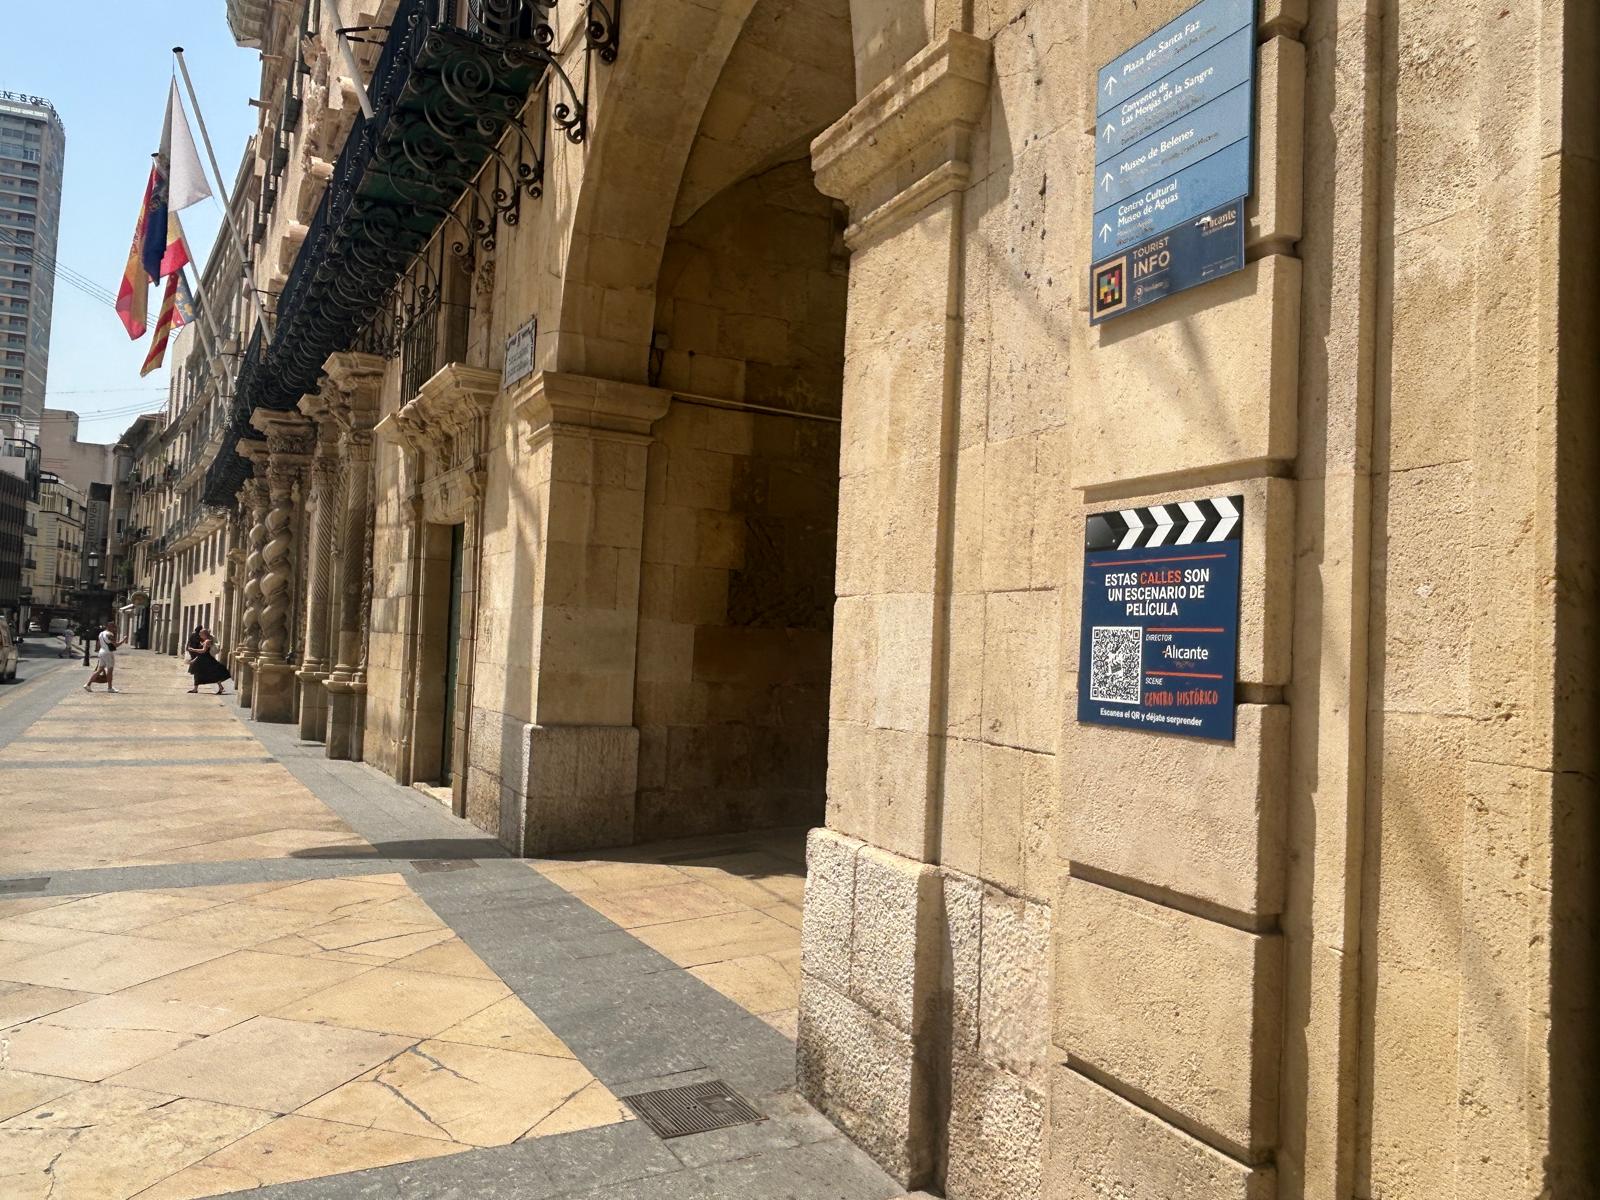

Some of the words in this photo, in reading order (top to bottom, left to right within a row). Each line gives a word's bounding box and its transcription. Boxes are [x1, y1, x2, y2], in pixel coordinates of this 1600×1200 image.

[1123, 57, 1144, 76] Plaza
[1146, 49, 1157, 61] de
[1158, 32, 1183, 53] Santa
[1185, 20, 1200, 36] Faz
[20, 93, 48, 106] SOL
[1121, 113, 1133, 126] Las
[1135, 98, 1161, 118] Monjas
[1163, 91, 1173, 102] de
[1175, 84, 1182, 94] la
[1184, 66, 1213, 89] Sangre
[1121, 89, 1157, 115] Convento
[1158, 82, 1168, 93] de
[1120, 155, 1146, 174] Museo
[1148, 147, 1158, 160] de
[1160, 128, 1194, 153] Belenes
[1118, 198, 1144, 216] Centro
[1145, 178, 1177, 203] Cultural
[1117, 211, 1142, 227] Museo
[1143, 205, 1152, 215] de
[1155, 192, 1178, 210] Aguas
[1133, 236, 1169, 260] TOURIST
[1133, 250, 1170, 278] INFO
[1105, 572, 1138, 587] ESTAS
[1140, 569, 1182, 585] CALLES
[1184, 568, 1210, 583] SON
[1108, 587, 1123, 602] UN
[1124, 585, 1187, 601] ESCENARIO
[1189, 584, 1205, 599] DE
[1126, 599, 1179, 616] PELÍCULA
[1145, 633, 1173, 642] DIRECTOR
[1164, 644, 1209, 660] Alicante
[1145, 677, 1163, 686] SCENE
[1144, 691, 1173, 707] CENTRO
[1176, 688, 1218, 706] HISTÓRICO
[1100, 707, 1124, 718] Escanea
[1124, 710, 1130, 719] el
[1131, 711, 1140, 720] QR
[1141, 714, 1145, 722] y
[1146, 712, 1165, 724] déjate
[1166, 716, 1202, 727] sorprender
